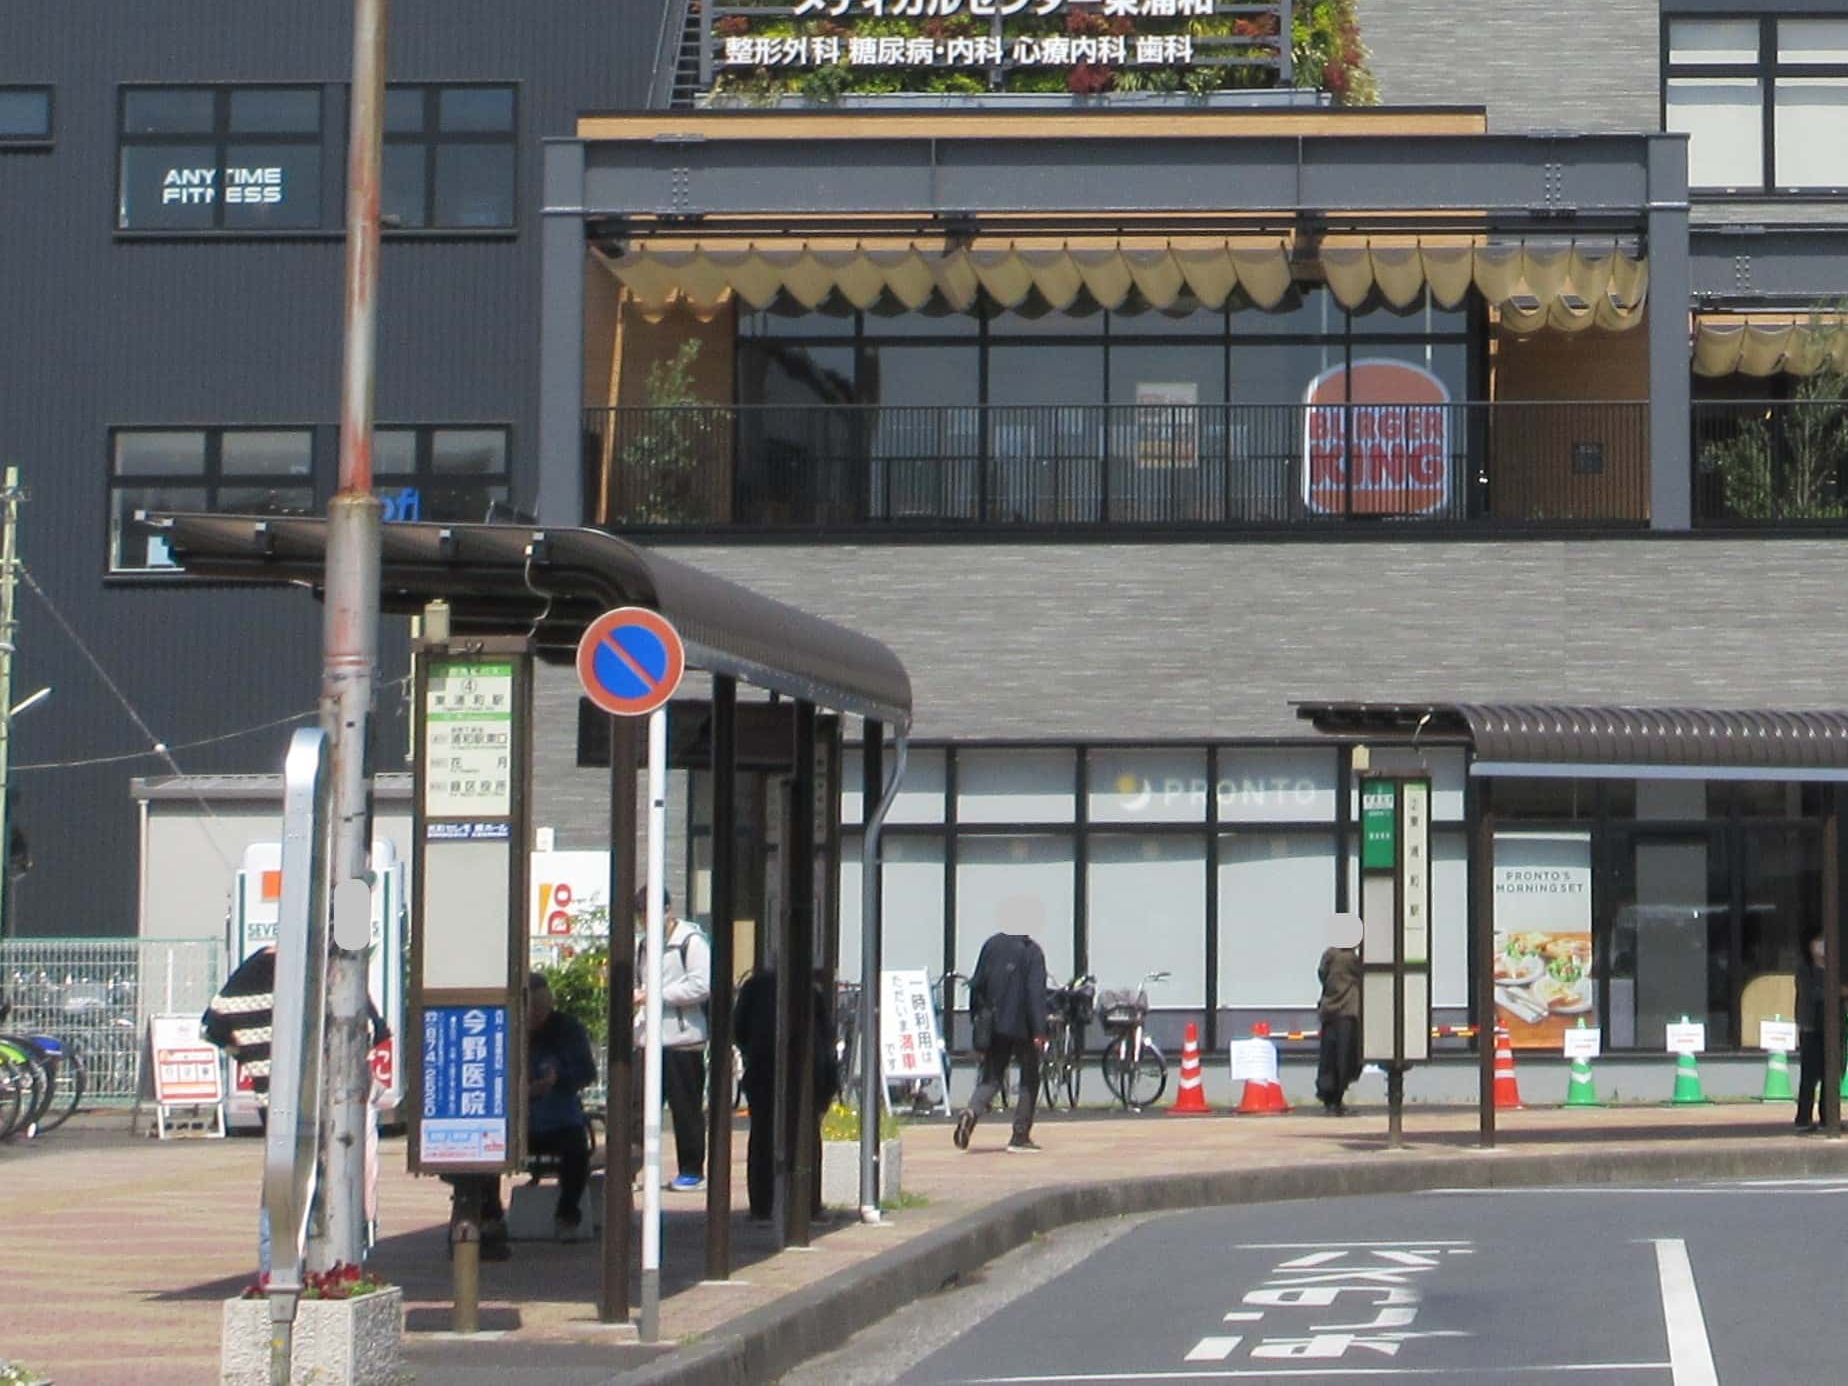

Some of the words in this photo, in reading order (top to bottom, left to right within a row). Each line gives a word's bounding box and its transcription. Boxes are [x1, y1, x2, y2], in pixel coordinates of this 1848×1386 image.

[725, 36, 841, 66] 整形外科
[850, 36, 1002, 66] 糖尿病・内科
[1013, 36, 1127, 66] 心療内科
[1136, 36, 1194, 66] 歯科
[1310, 410, 1444, 443] BURGER
[1310, 445, 1444, 488] KING
[1163, 777, 1317, 808] PRONTO
[1496, 883, 1557, 894] MORNING
[1560, 883, 1584, 894] SET
[462, 1009, 487, 1116] 今野医院
